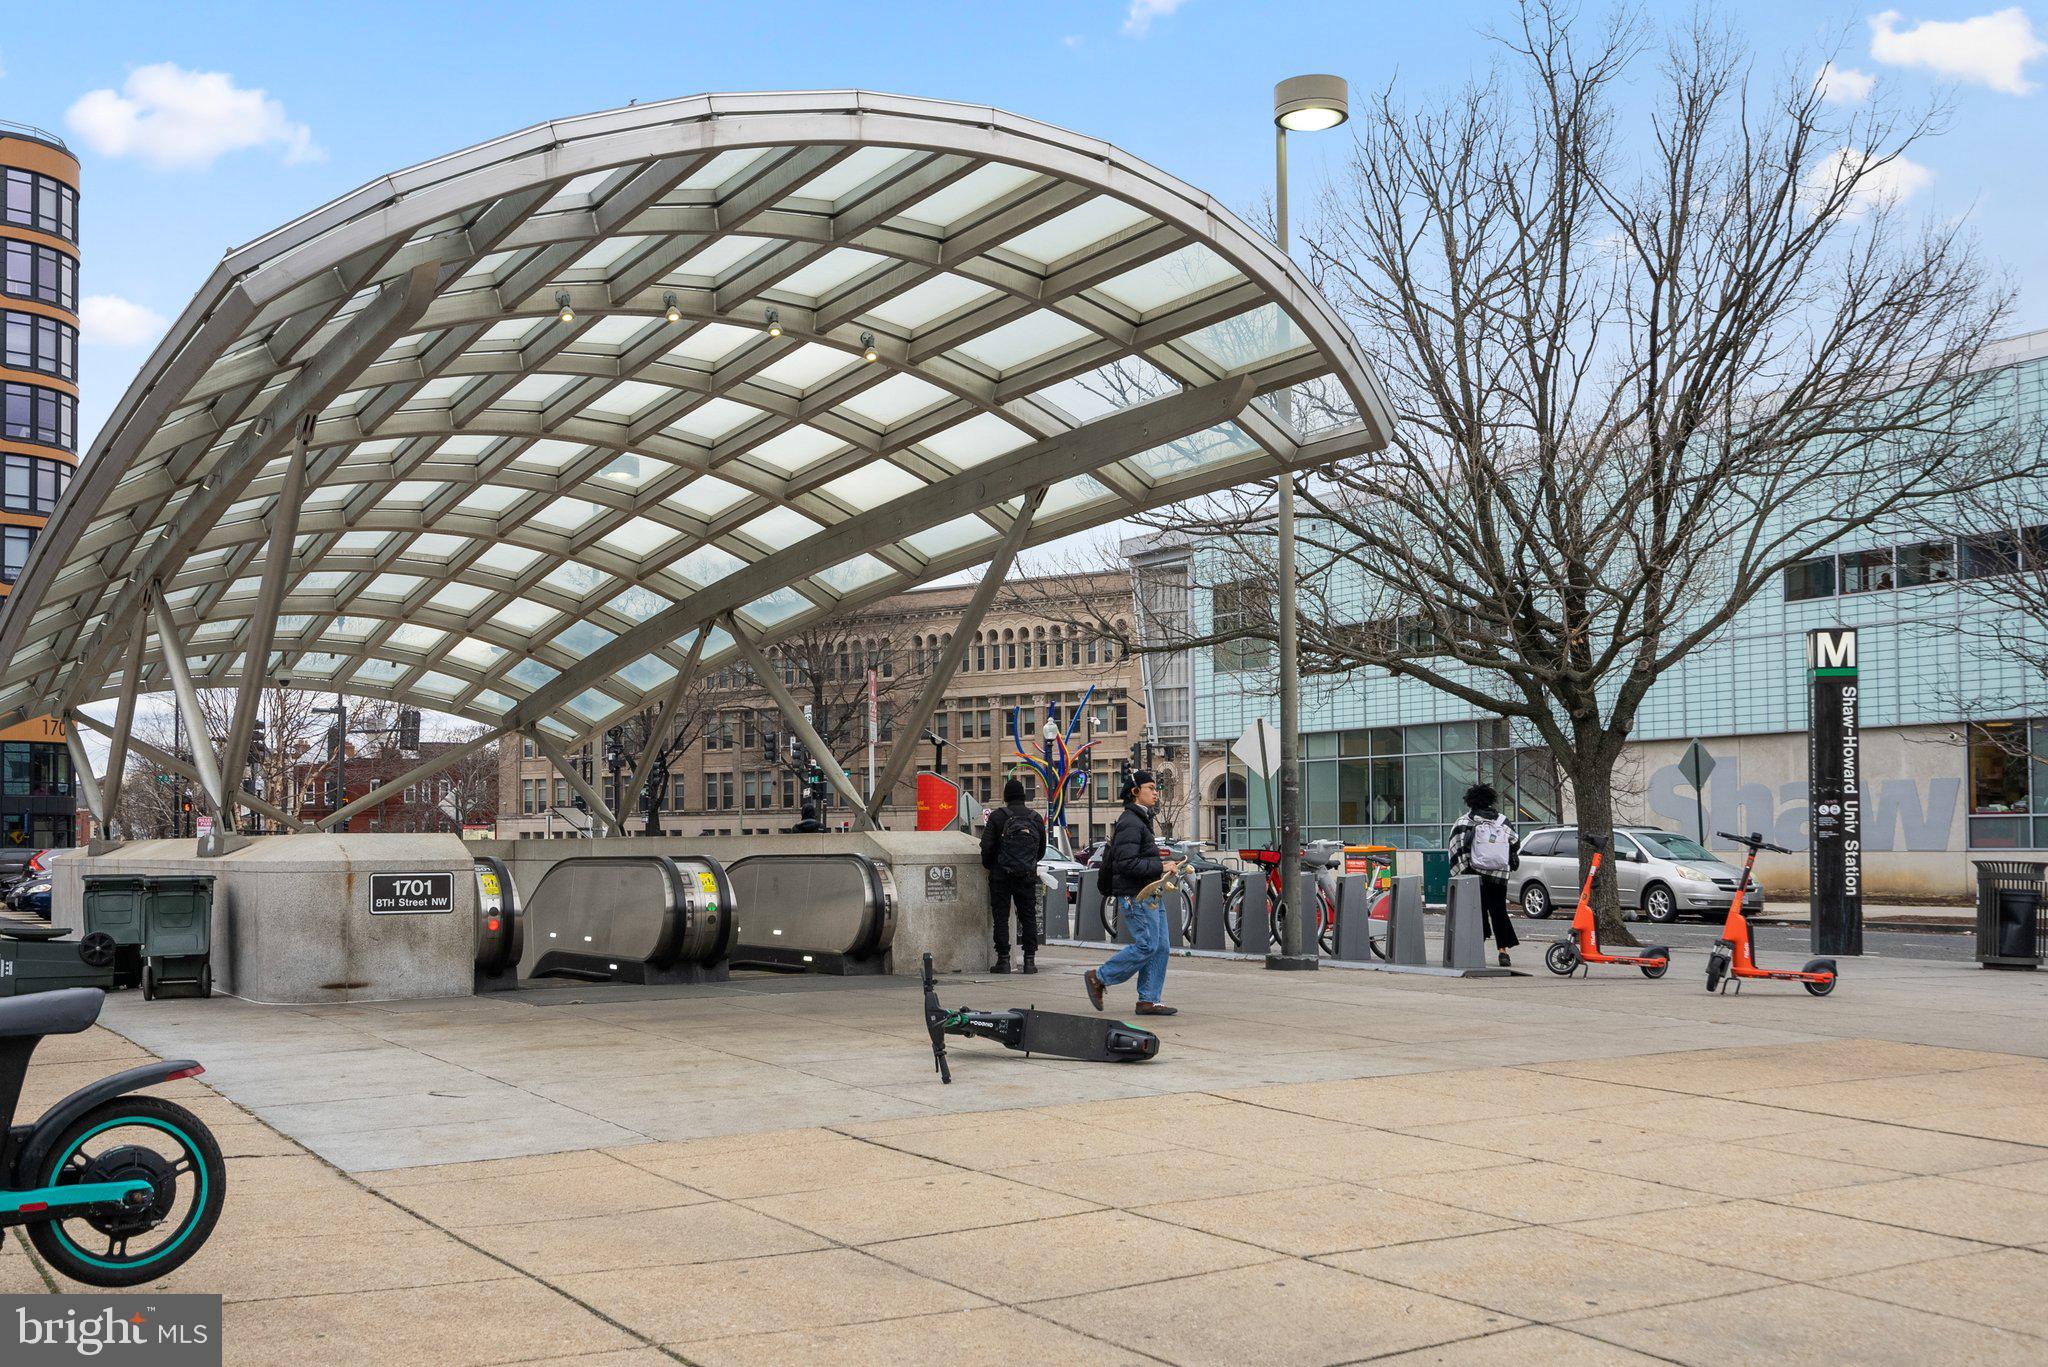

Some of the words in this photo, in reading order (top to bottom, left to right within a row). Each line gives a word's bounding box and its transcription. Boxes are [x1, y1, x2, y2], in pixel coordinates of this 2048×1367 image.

[1816, 631, 1857, 668] M
[1841, 686, 1858, 795] Shaw-Howard
[1843, 800, 1859, 834] Univ
[1844, 839, 1860, 896] Station
[375, 898, 395, 908] 8TH
[398, 898, 428, 907] Street
[431, 897, 448, 906] NW
[391, 879, 433, 896] 1701
